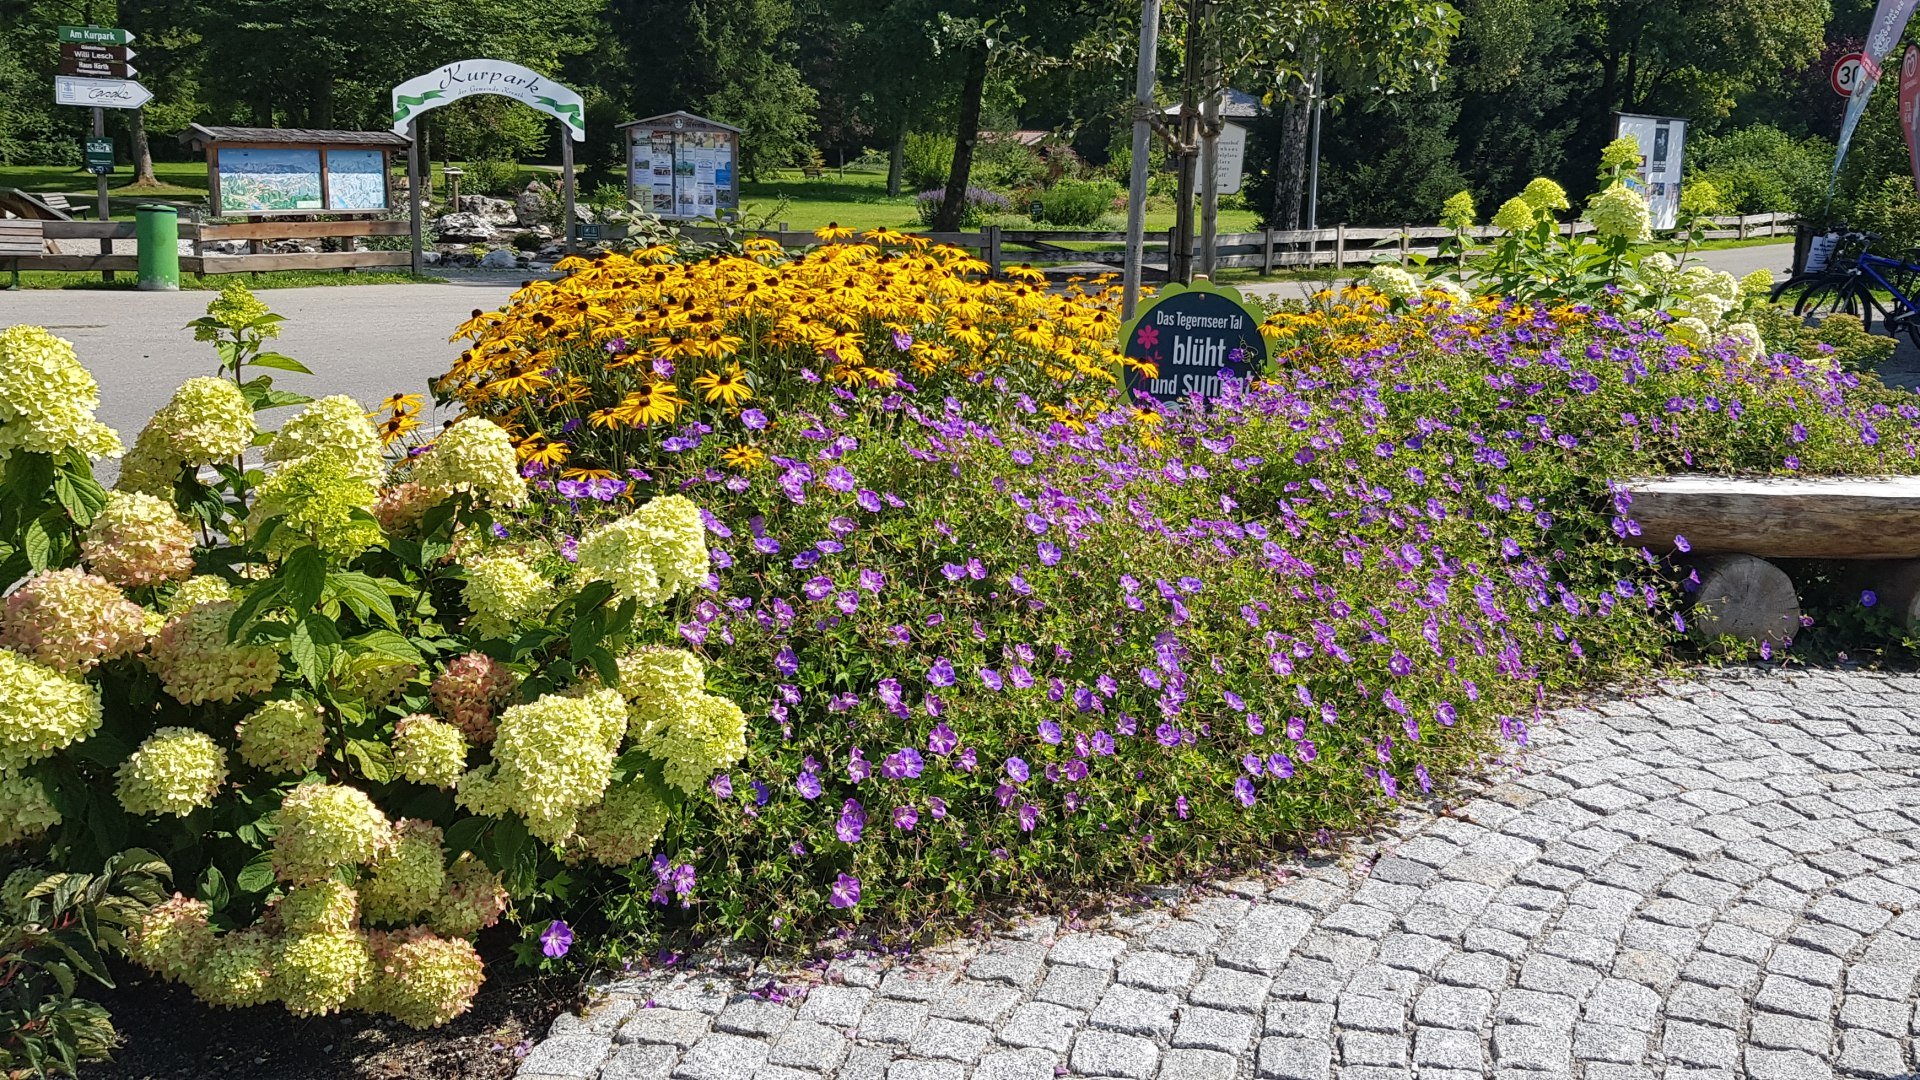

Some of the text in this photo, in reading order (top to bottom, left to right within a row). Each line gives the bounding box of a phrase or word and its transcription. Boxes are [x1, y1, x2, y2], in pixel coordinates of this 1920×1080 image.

[69, 29, 116, 41] Am Kurpark
[91, 51, 114, 60] Lesch
[439, 63, 540, 94] Kurpark
[469, 84, 500, 94] Gemeinde
[1156, 310, 1244, 331] Das Tegernseer Tal
[1172, 335, 1227, 368] blüht
[1150, 374, 1178, 395] und
